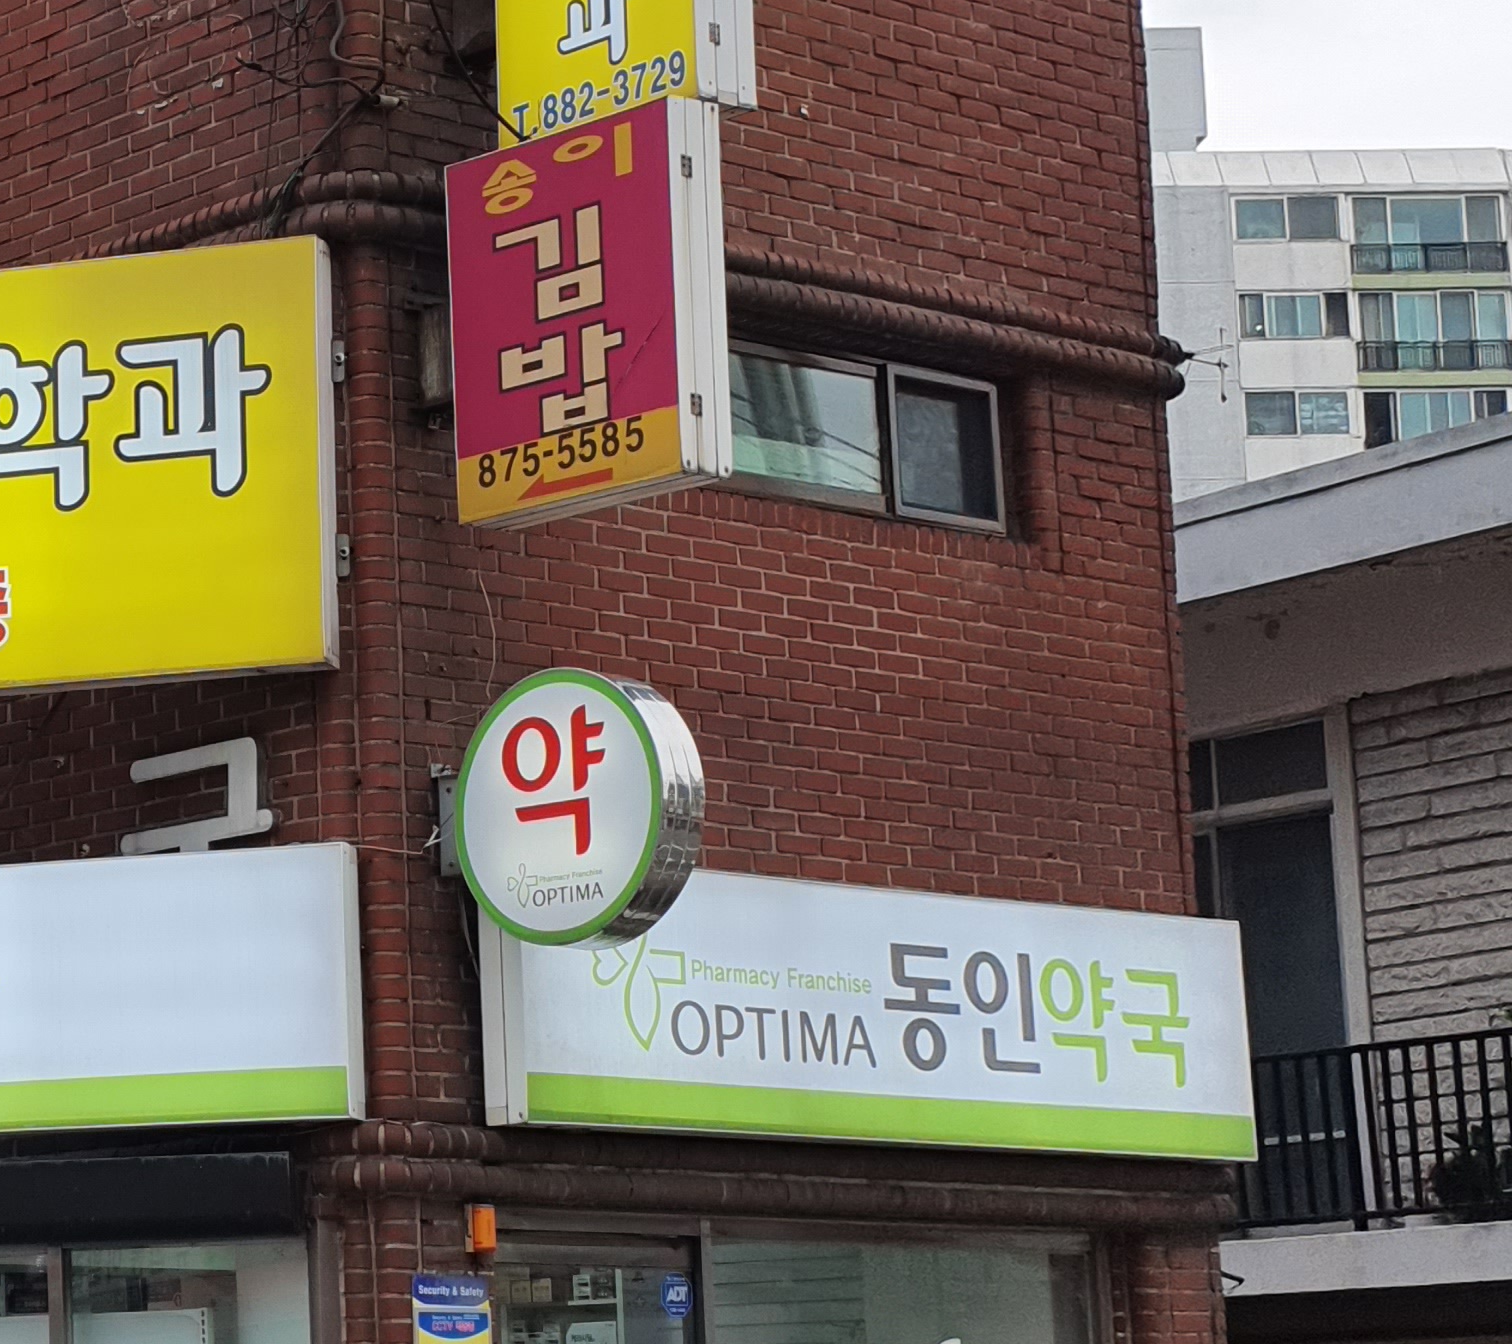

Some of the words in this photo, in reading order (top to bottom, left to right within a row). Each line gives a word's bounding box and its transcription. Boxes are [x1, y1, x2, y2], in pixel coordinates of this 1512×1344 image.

[512, 50, 687, 137] T.882-3729
[482, 122, 633, 215] 송이
[493, 200, 625, 437] 김밥
[478, 415, 645, 489] 875-5585
[501, 703, 606, 856] 약
[532, 881, 604, 908] OPTIMA
[539, 872, 570, 884] Pharmacy
[571, 867, 603, 879] Franchise
[690, 958, 781, 992] Pharmacy
[787, 966, 872, 995] Franchise
[670, 1000, 878, 1069] OPTIMA
[884, 942, 1189, 1089] 동인약국
[418, 1284, 450, 1296] Security
[460, 1286, 484, 1297] Safety
[666, 1286, 688, 1302] ADT
